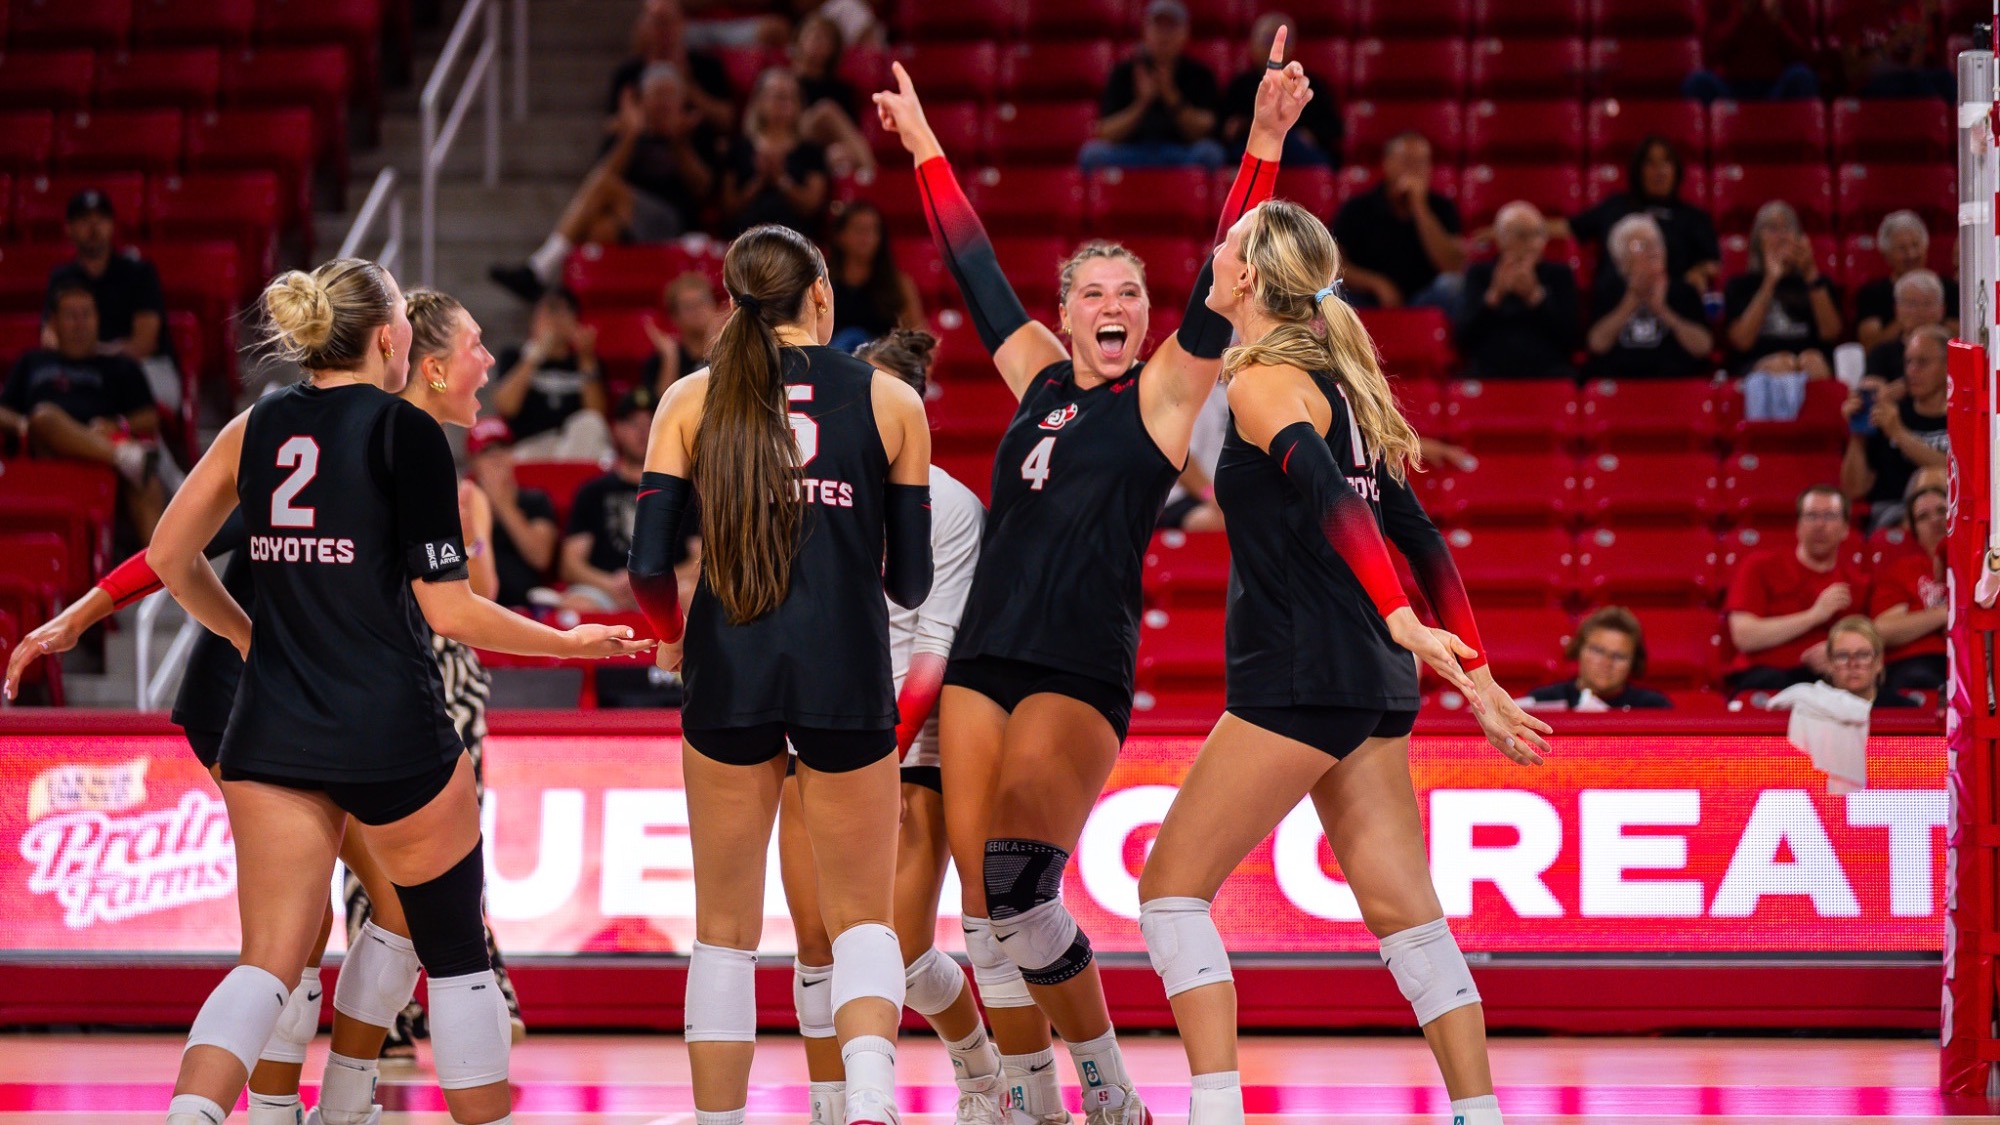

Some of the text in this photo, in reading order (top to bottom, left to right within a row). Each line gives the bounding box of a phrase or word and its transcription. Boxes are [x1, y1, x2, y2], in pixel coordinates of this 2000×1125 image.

[270, 435, 320, 528] 2
[1021, 436, 1057, 491] 4
[250, 536, 355, 564] COYOTES
[440, 555, 461, 566] ARYSE
